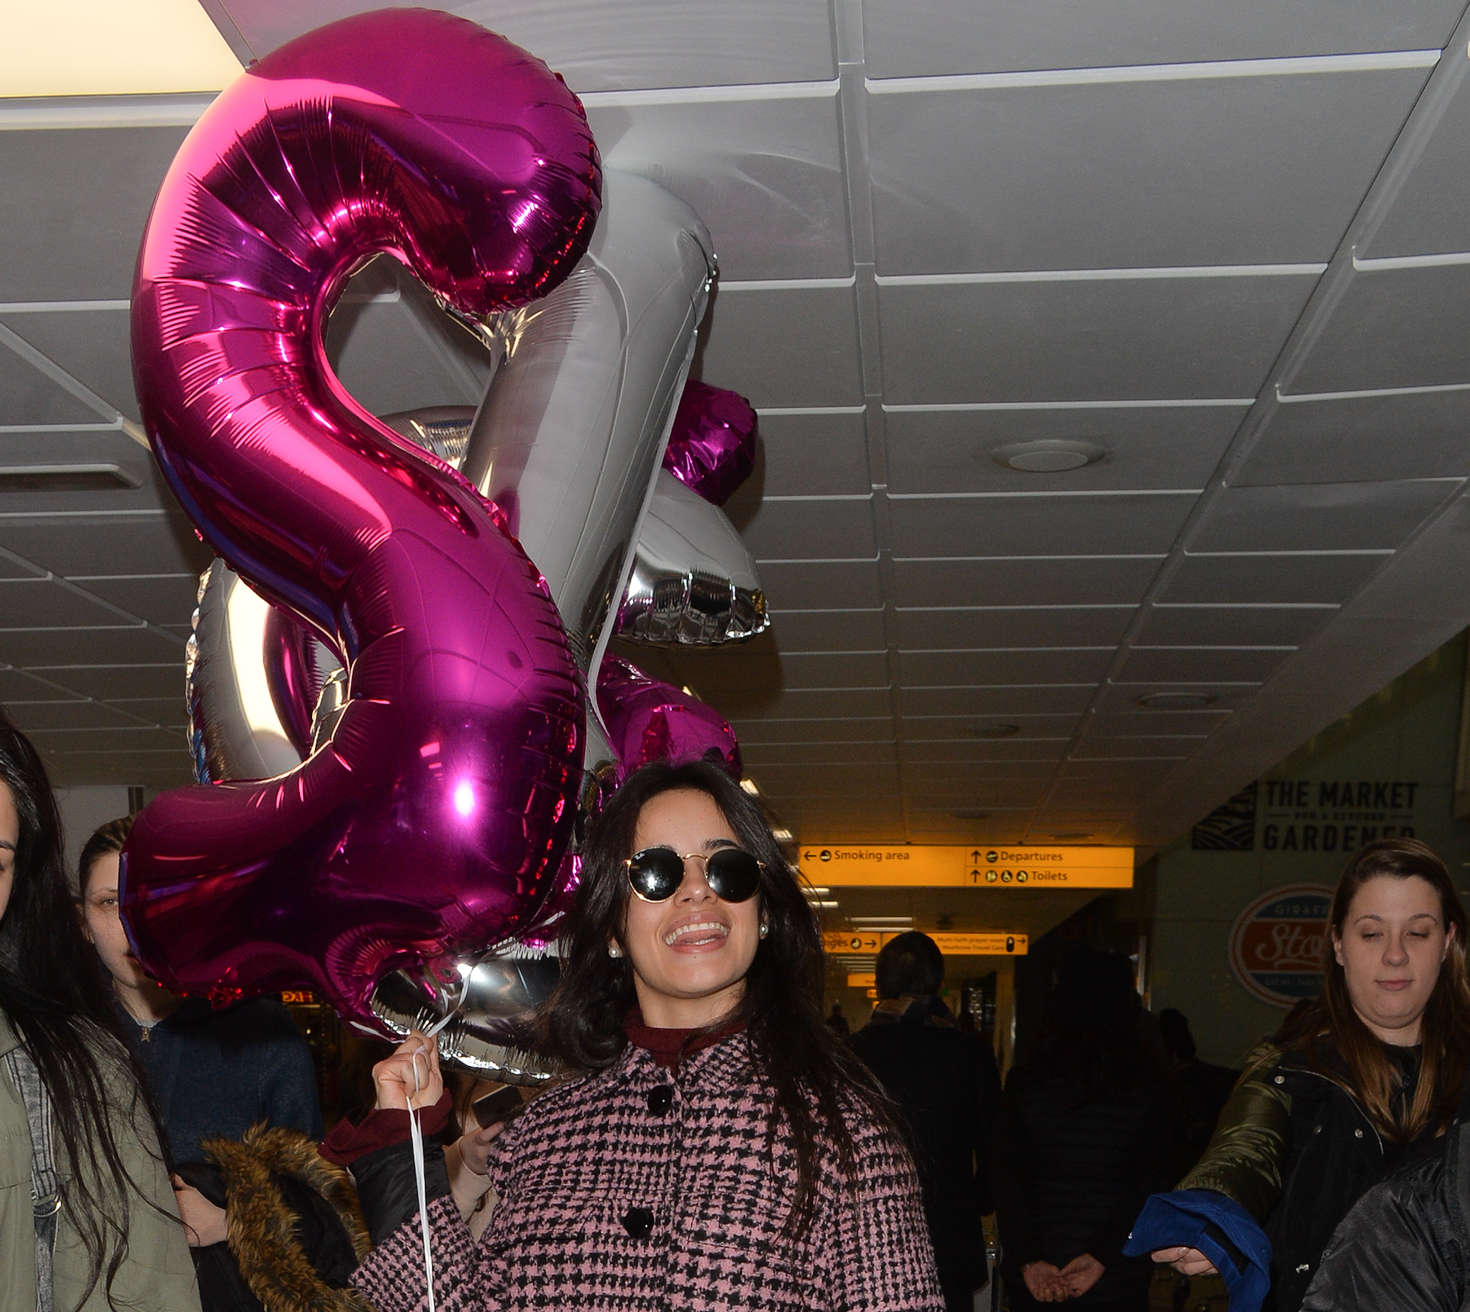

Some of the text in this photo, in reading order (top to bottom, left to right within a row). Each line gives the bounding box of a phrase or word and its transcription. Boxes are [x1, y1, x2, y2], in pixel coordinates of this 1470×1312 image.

[1266, 780, 1418, 809] THE MARKET
[834, 849, 910, 862] Smoking area
[1000, 851, 1063, 863] Departures
[1031, 870, 1068, 881] Toilets
